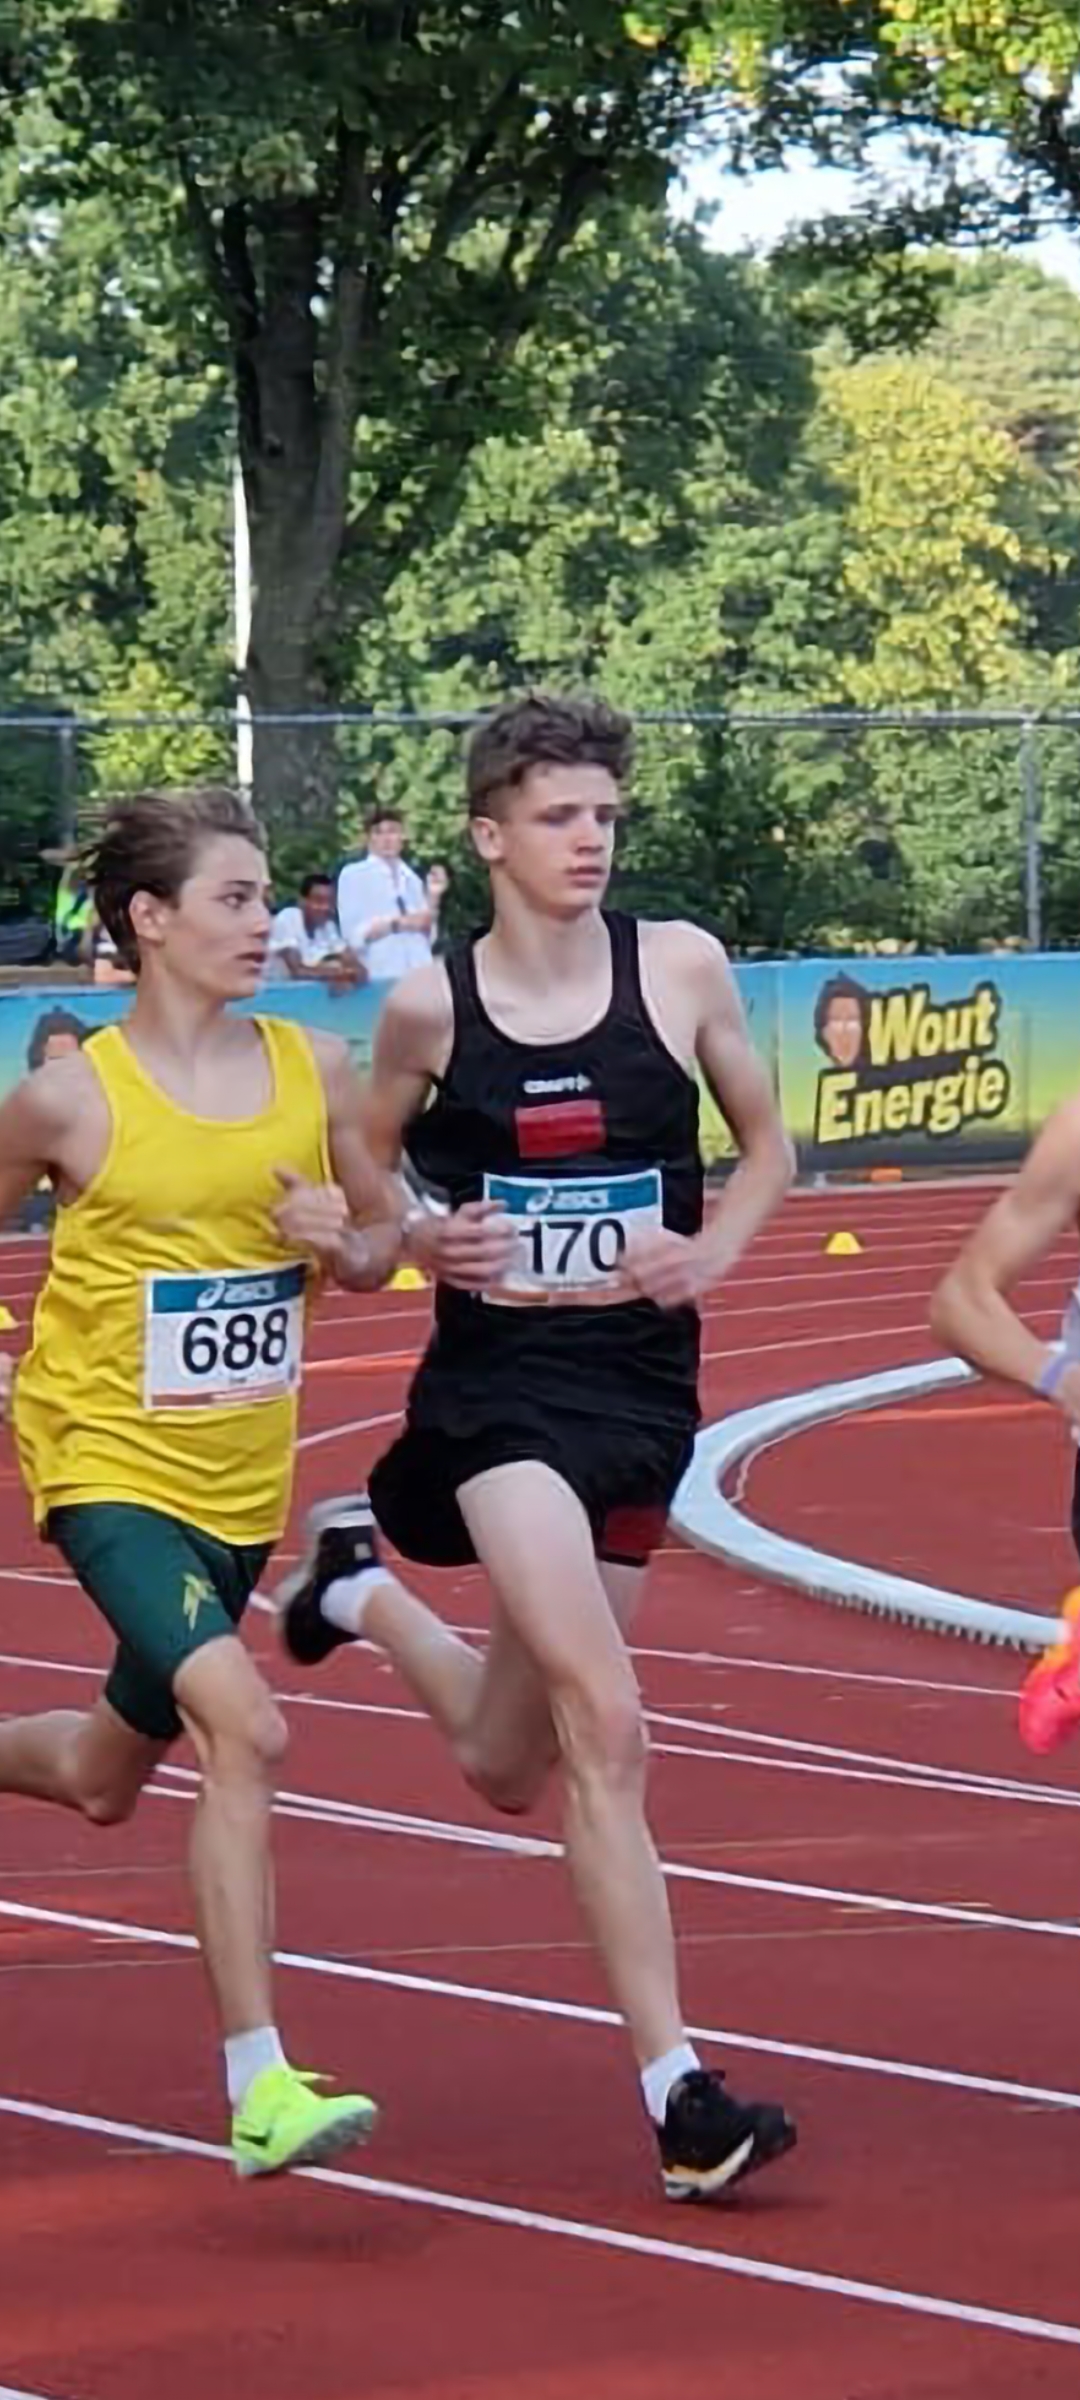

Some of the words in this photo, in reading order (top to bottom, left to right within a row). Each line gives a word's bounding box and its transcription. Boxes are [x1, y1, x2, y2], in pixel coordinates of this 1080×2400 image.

[868, 986, 996, 1067] Wout
[817, 1054, 1007, 1144] Energie
[519, 1217, 627, 1275] 170
[182, 1308, 289, 1375] 688
